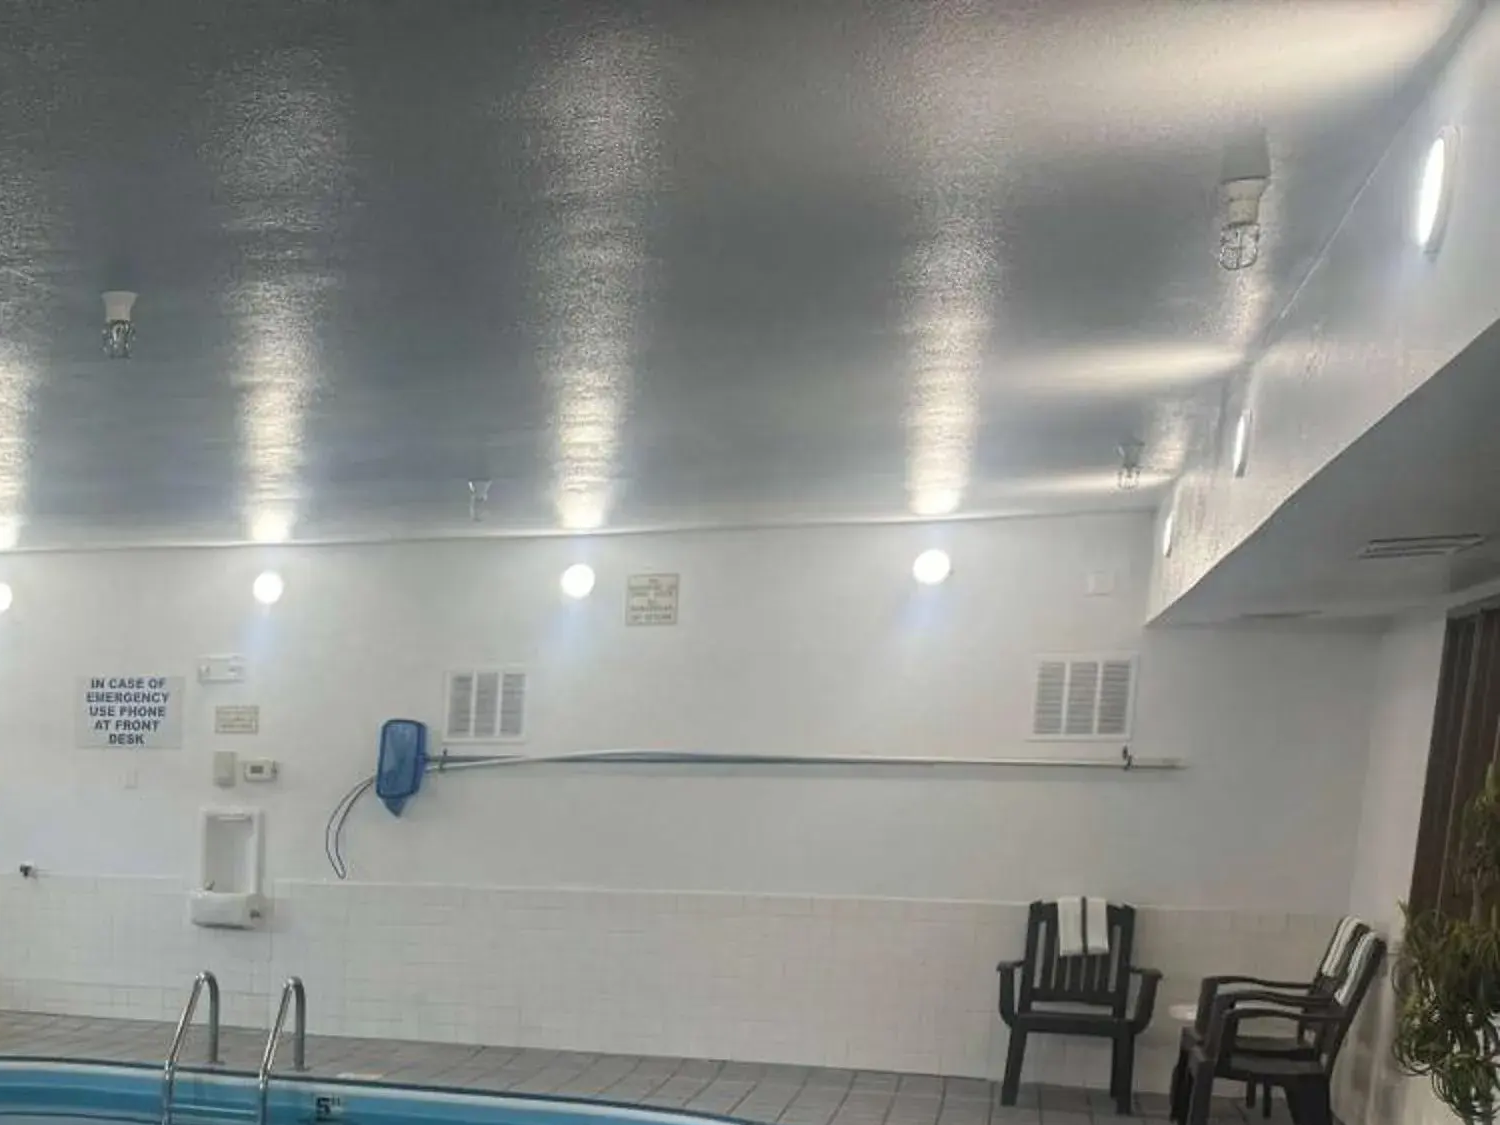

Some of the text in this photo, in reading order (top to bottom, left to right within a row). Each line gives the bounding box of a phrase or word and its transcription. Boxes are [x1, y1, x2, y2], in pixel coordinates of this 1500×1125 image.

[91, 678, 166, 689] IN CASE OF
[86, 692, 169, 703] EMERGENCY
[89, 706, 166, 717] USE PHONE
[94, 720, 160, 732] AT FRONT
[109, 734, 145, 745] DESK
